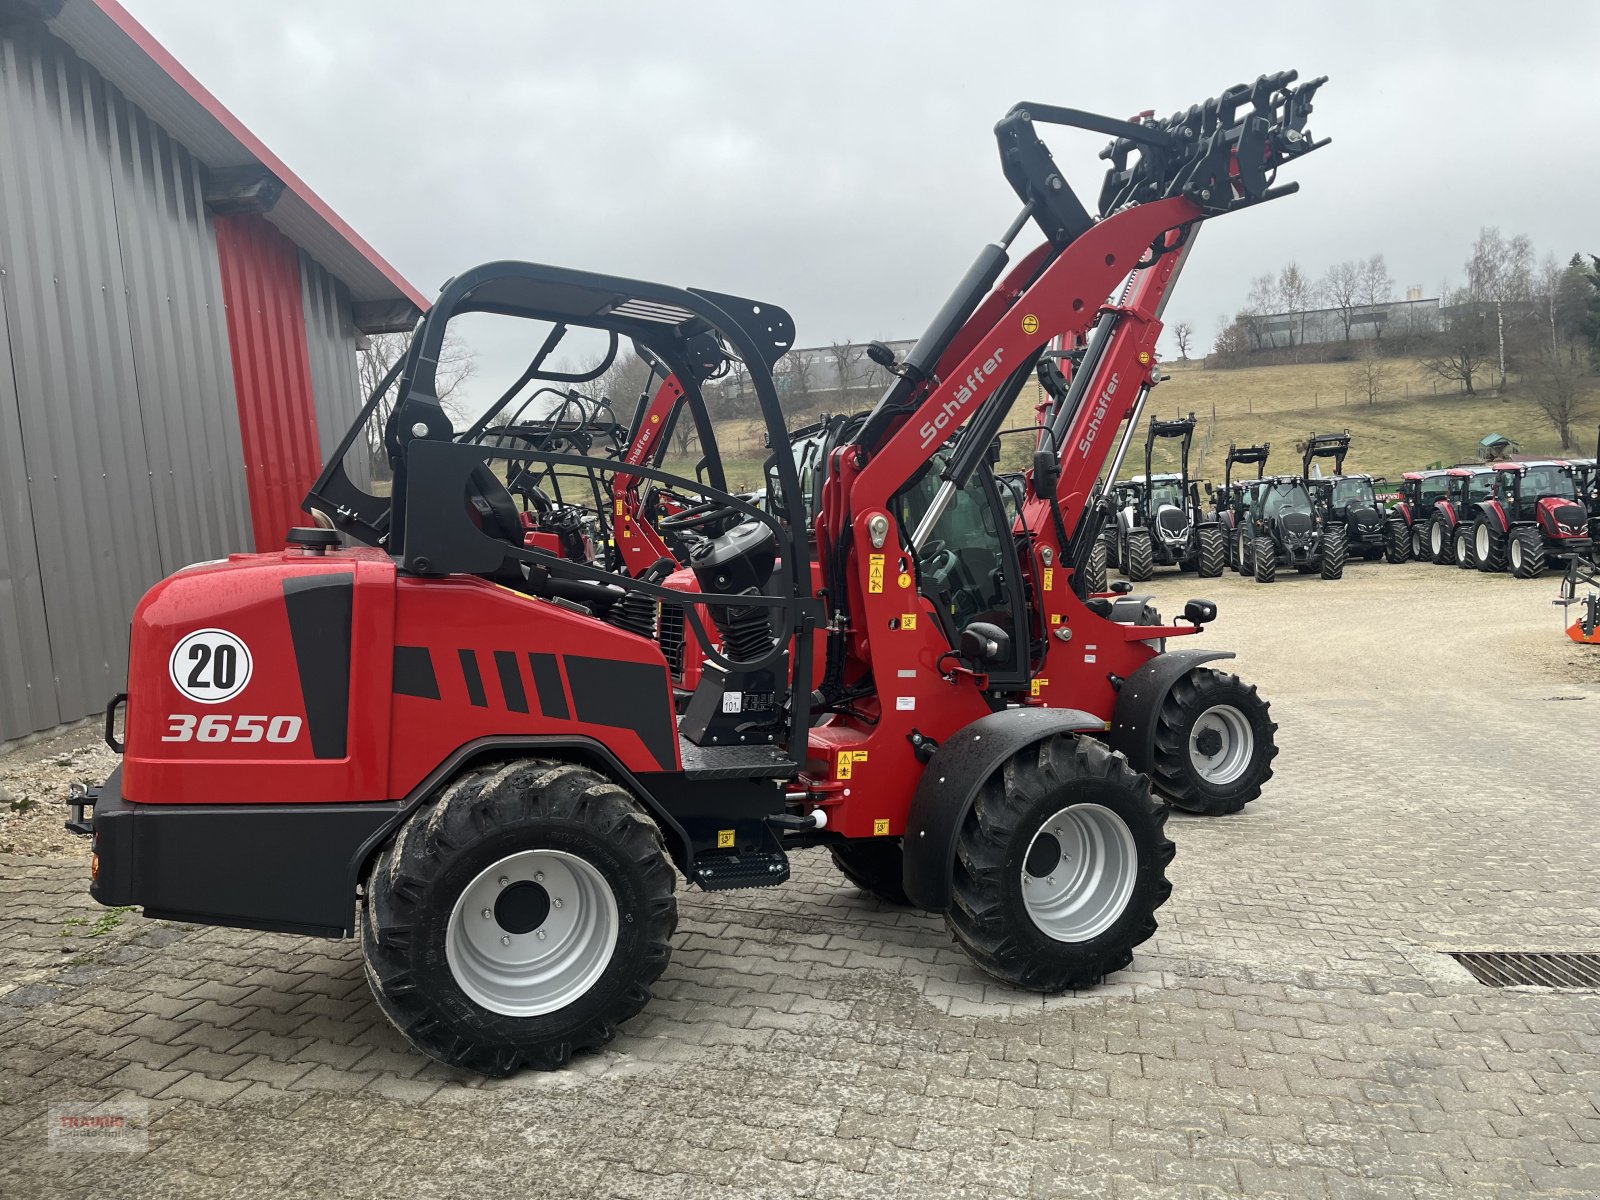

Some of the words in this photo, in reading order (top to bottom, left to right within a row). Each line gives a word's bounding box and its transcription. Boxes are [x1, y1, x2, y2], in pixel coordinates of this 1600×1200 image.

[919, 347, 1004, 450] Schäffer
[1078, 372, 1119, 459] Schäffer
[629, 428, 651, 465] häffer
[187, 643, 237, 690] 20
[725, 702, 737, 712] 101
[161, 714, 303, 743] 3650
